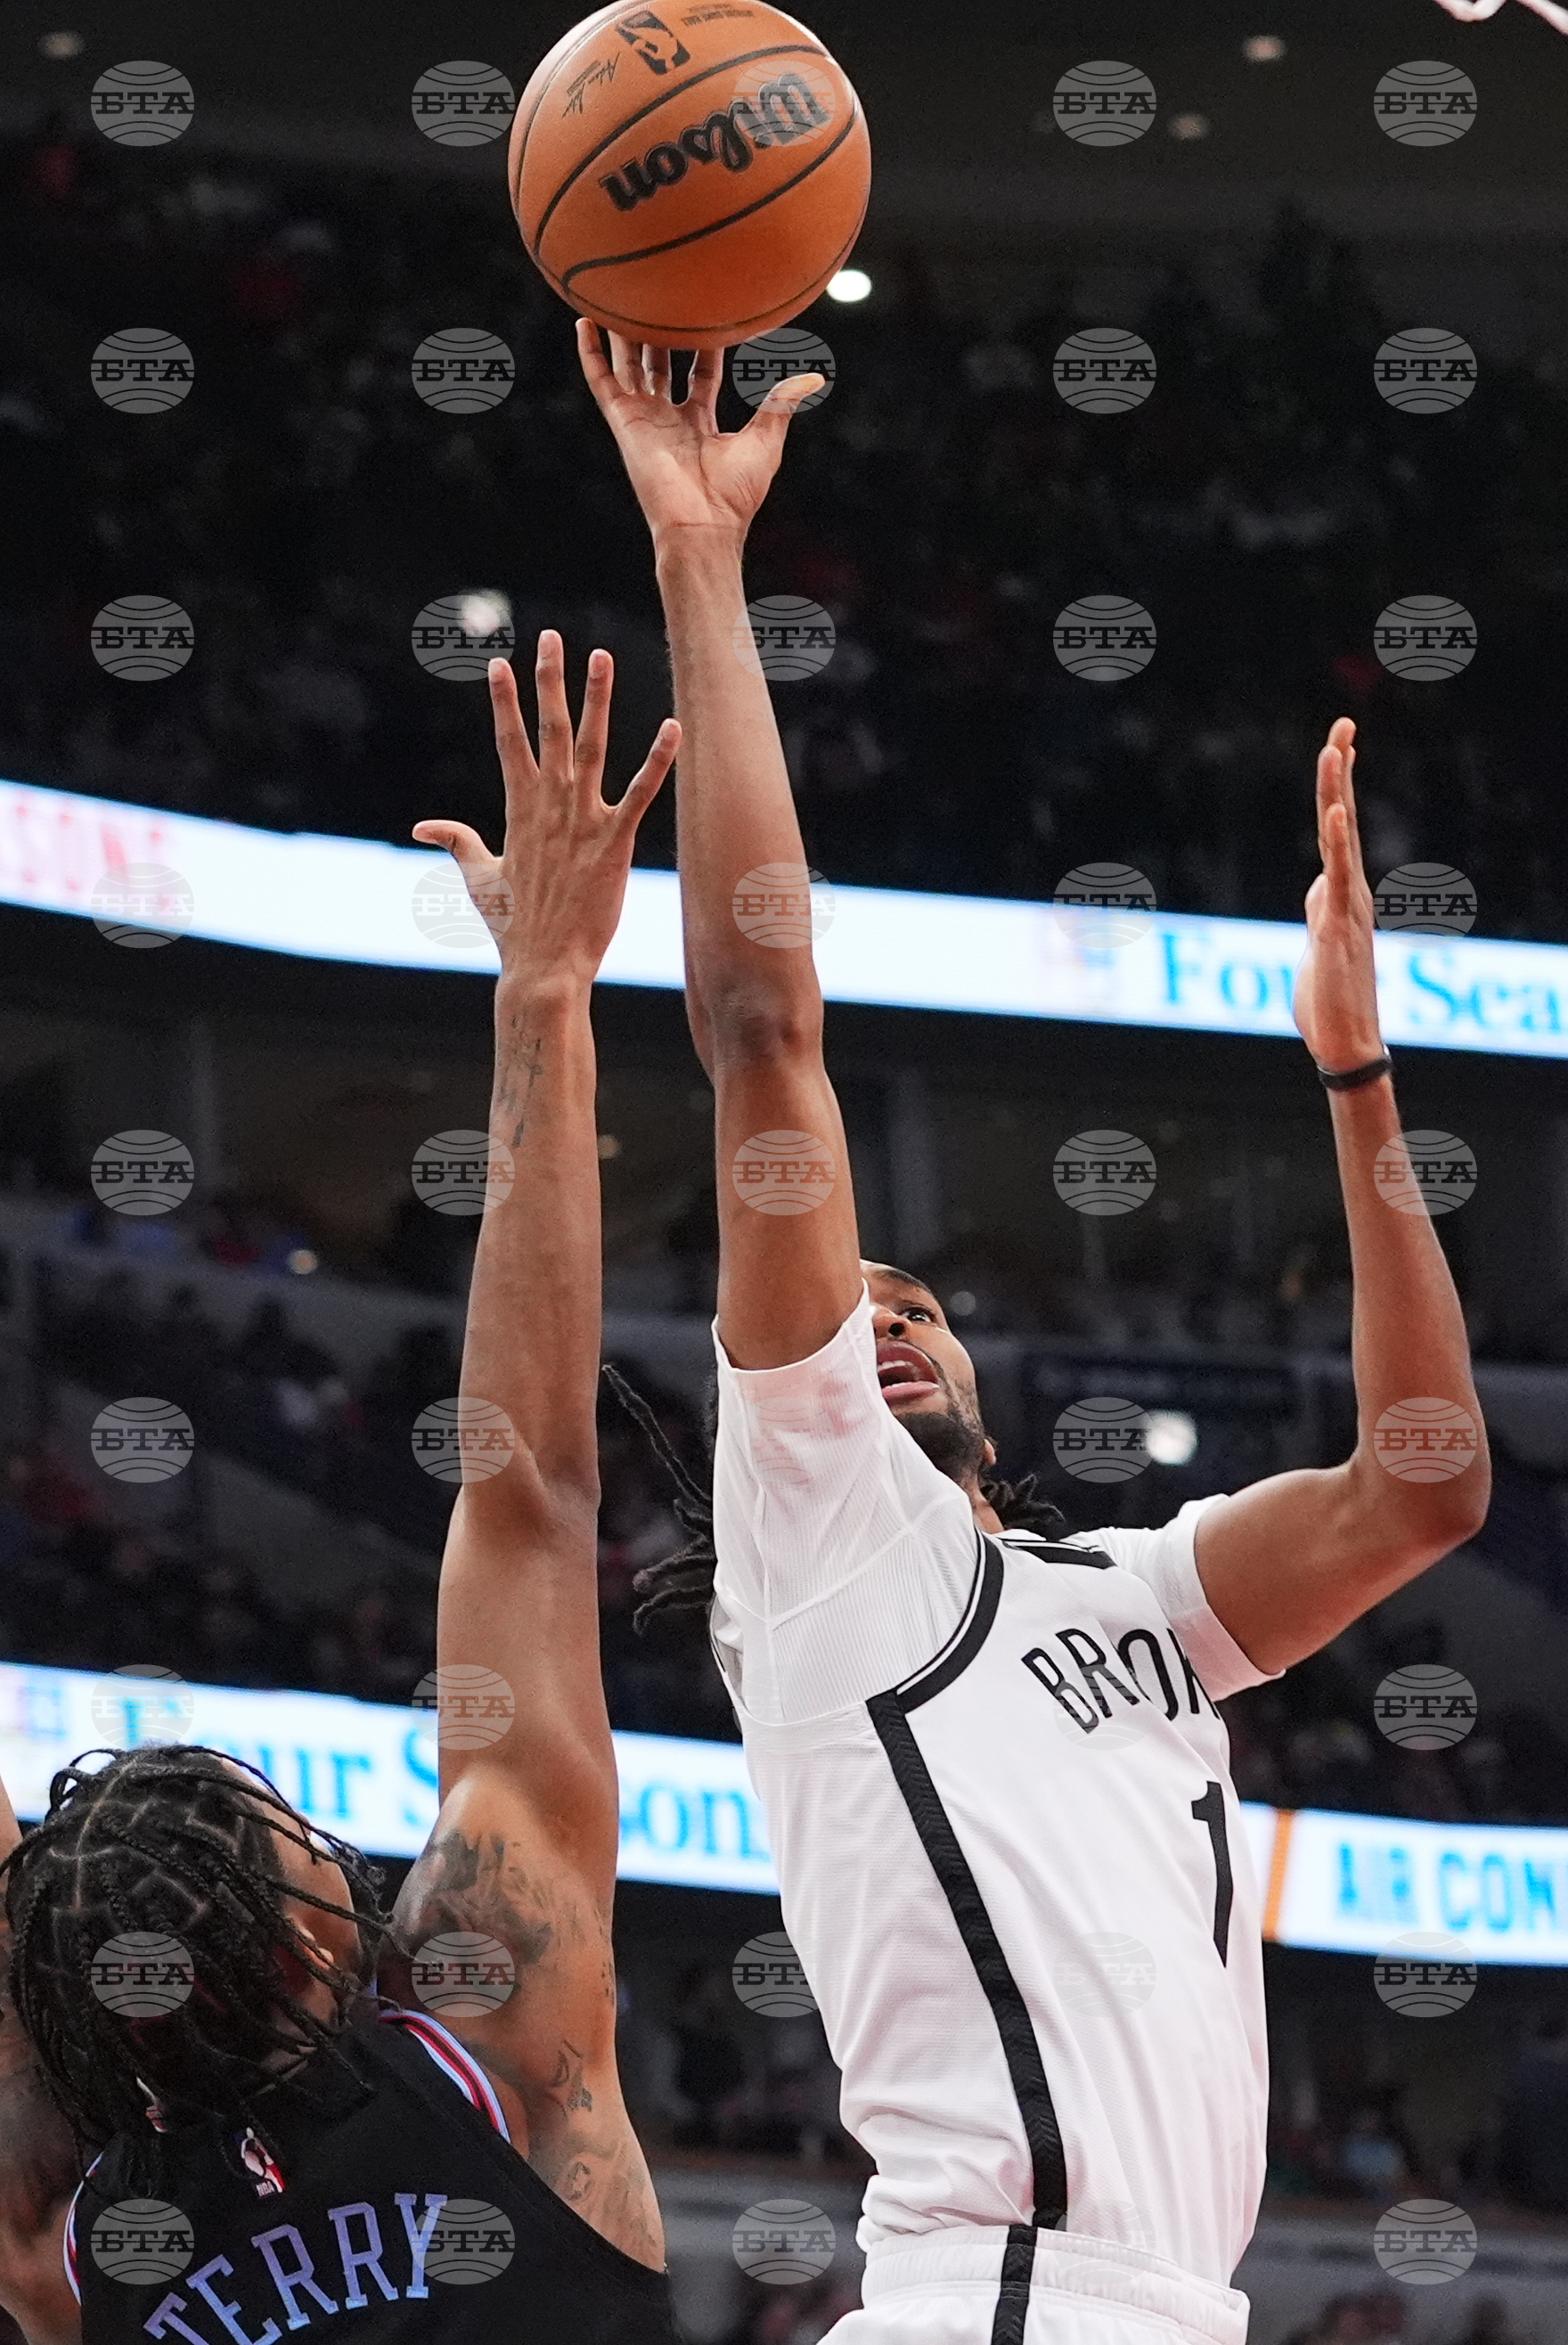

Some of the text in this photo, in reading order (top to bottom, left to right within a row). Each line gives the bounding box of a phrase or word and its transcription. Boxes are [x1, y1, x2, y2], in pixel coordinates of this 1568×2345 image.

[599, 73, 830, 212] Wilson
[1191, 1780, 1234, 1969] 1
[143, 2192, 448, 2345] TERRY
